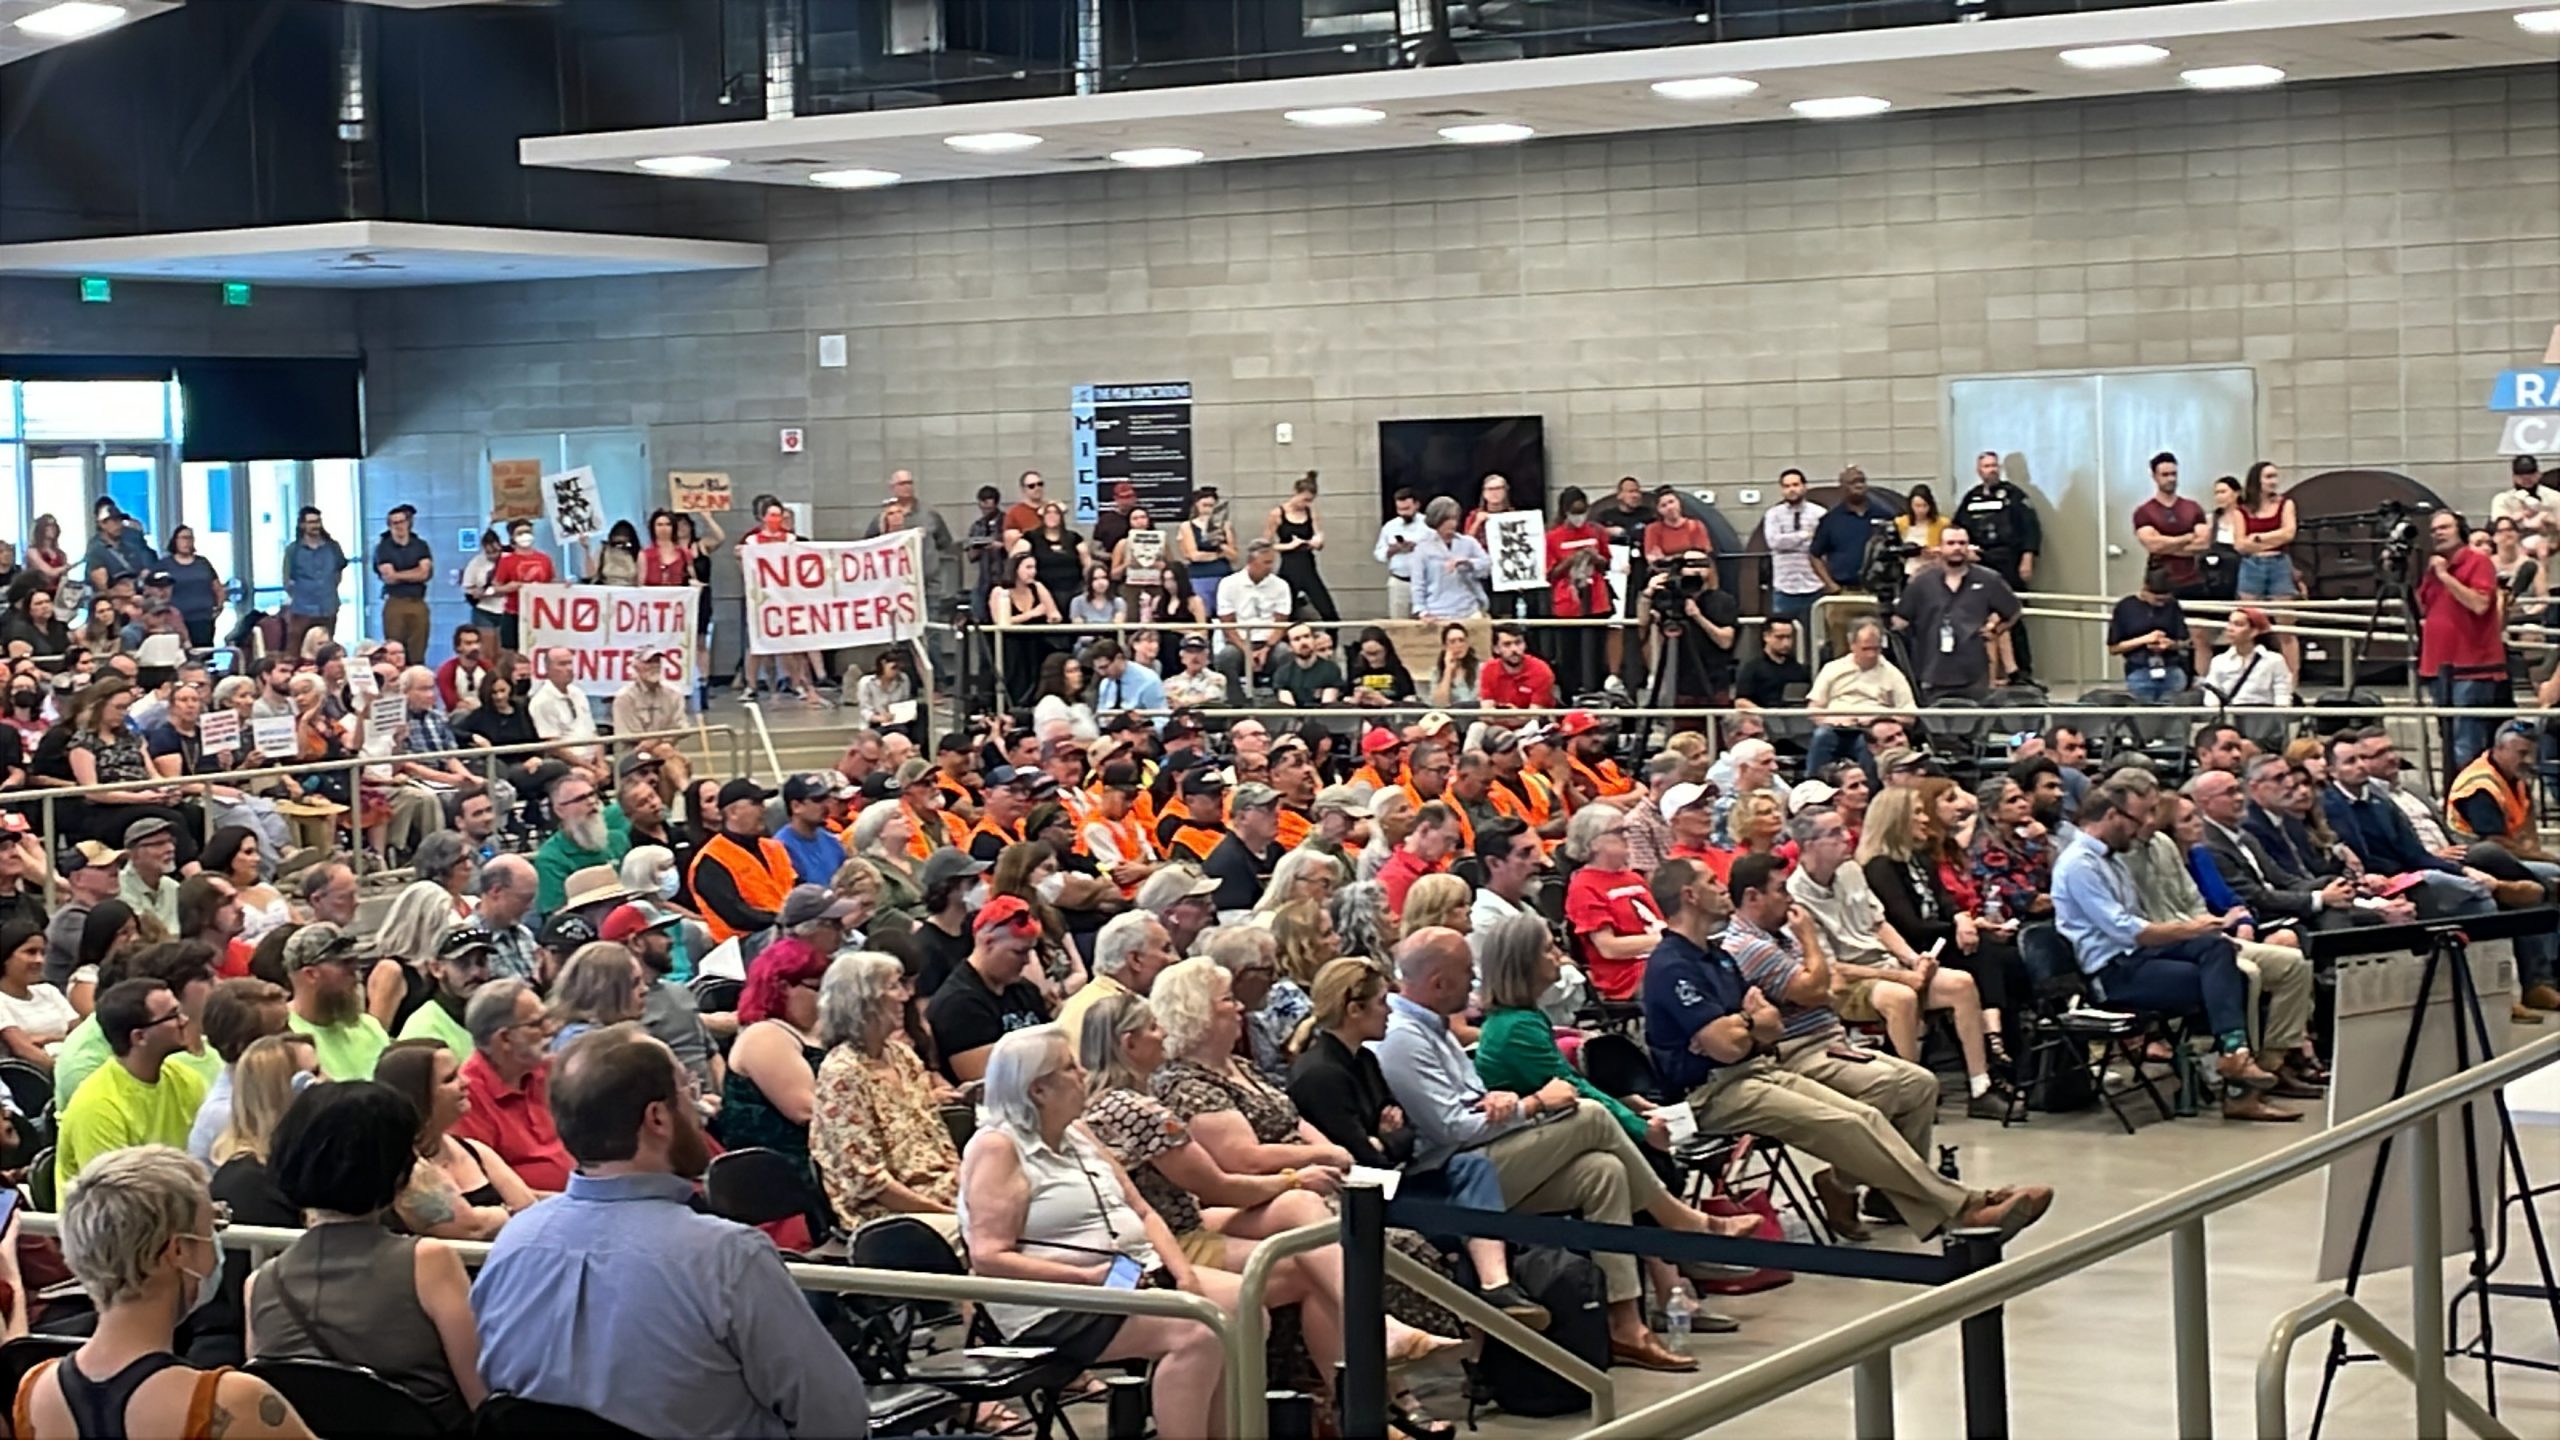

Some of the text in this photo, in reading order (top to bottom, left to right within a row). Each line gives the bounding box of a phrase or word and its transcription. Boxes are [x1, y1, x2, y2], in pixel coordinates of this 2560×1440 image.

[841, 545, 913, 583] DATA
[616, 600, 686, 632] DATA
[764, 592, 916, 638] CENTERS
[534, 648, 682, 681] CNTES
